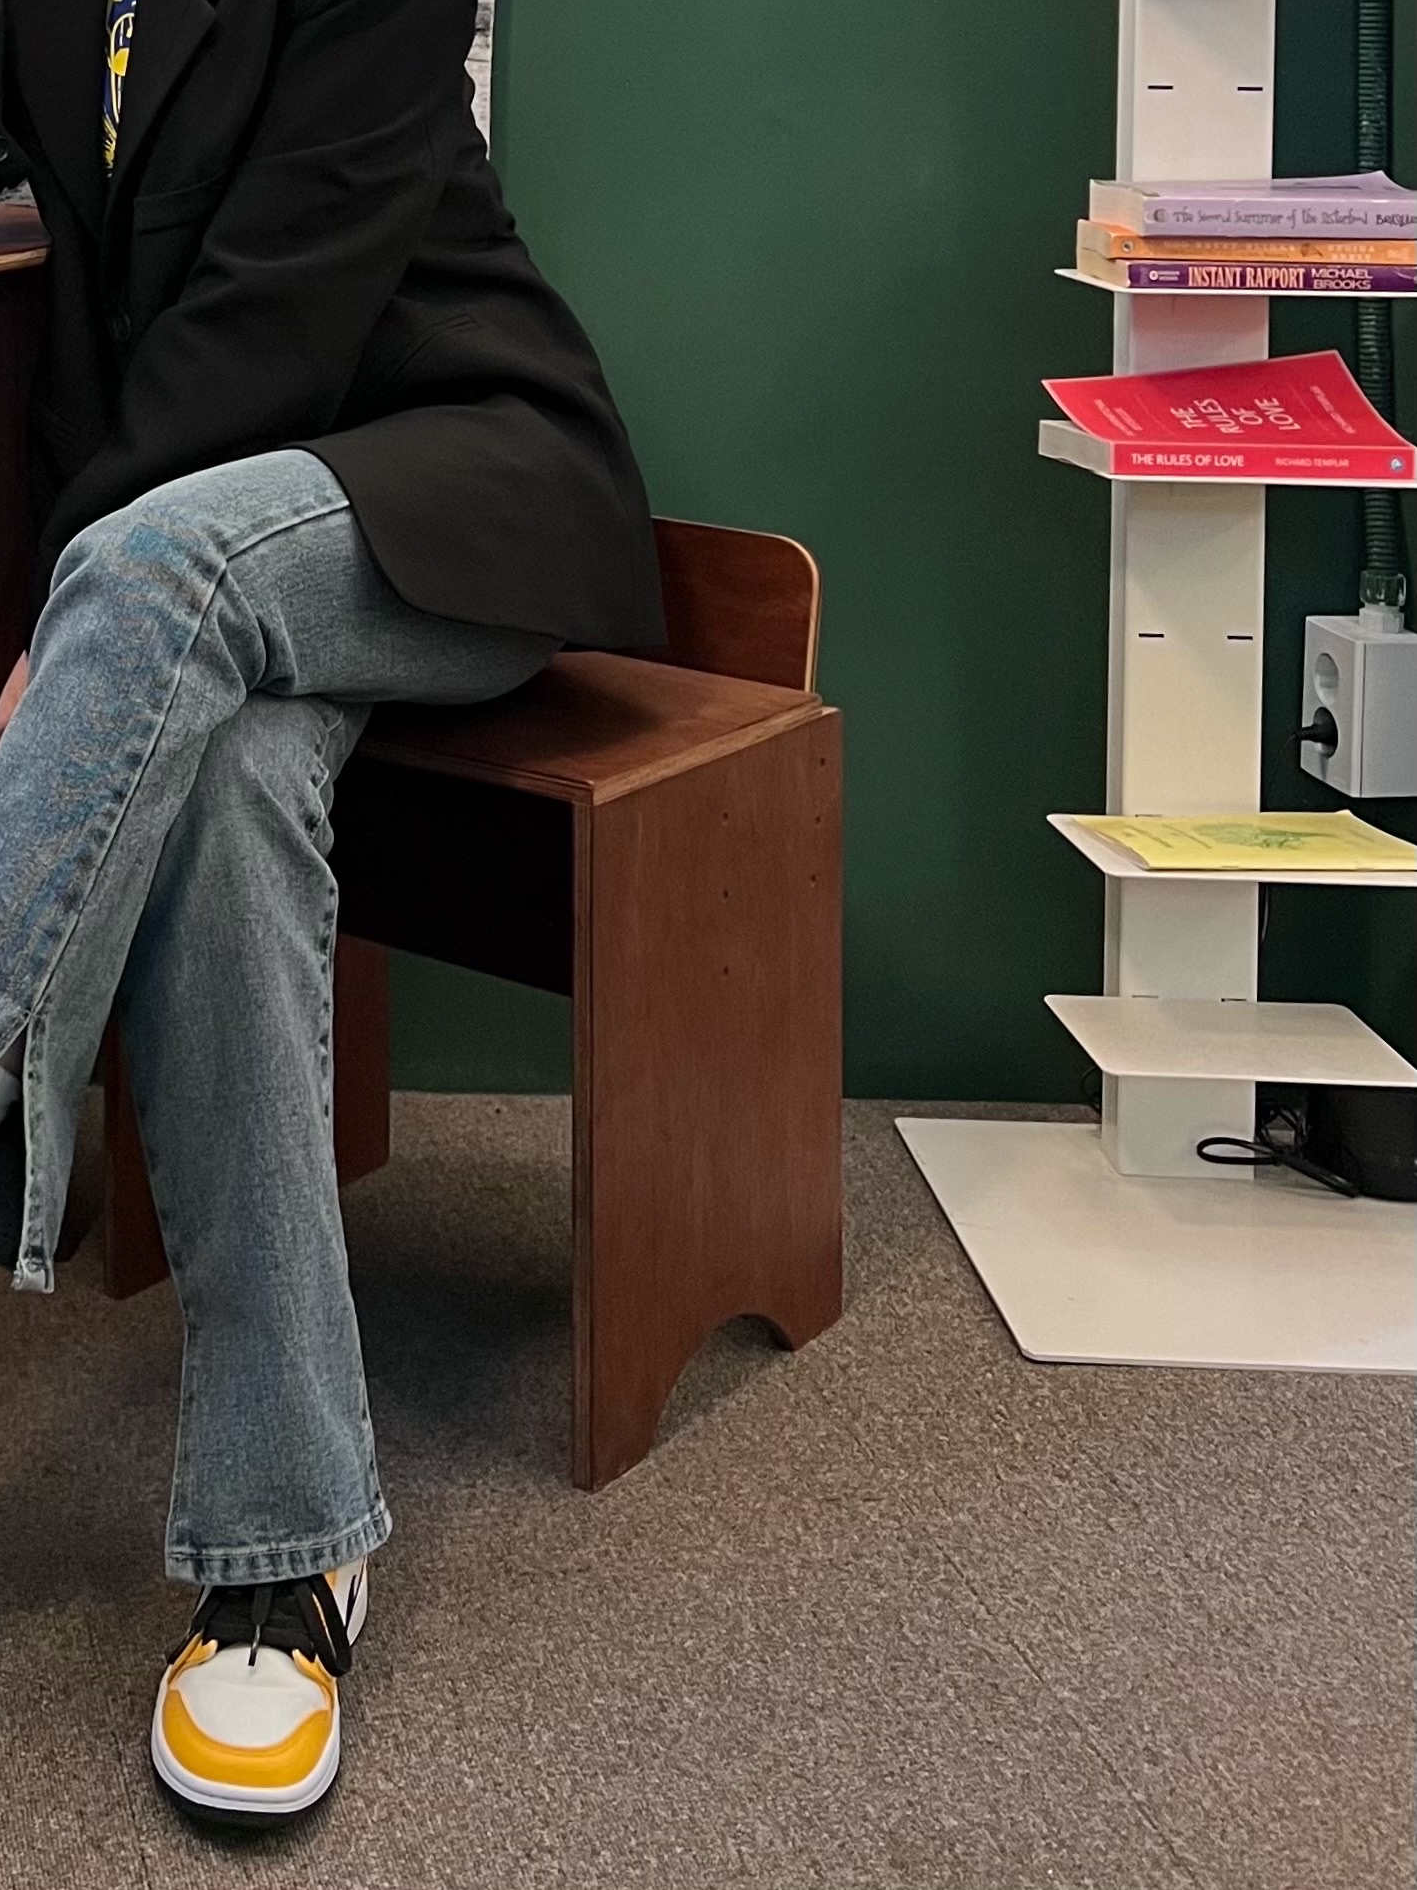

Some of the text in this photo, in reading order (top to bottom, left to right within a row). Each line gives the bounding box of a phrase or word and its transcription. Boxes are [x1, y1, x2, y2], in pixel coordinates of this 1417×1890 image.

[1188, 266, 1243, 288] INSTANT
[1245, 267, 1306, 289] RAPPORT
[1311, 268, 1373, 279] MICHAEL
[1313, 279, 1372, 290] BROOKS
[1170, 407, 1208, 429] THE
[1193, 398, 1245, 433] RULES
[1230, 407, 1263, 425] OF
[1254, 397, 1301, 430] LOVE
[1131, 453, 1245, 467] THE RULES OF LOVE
